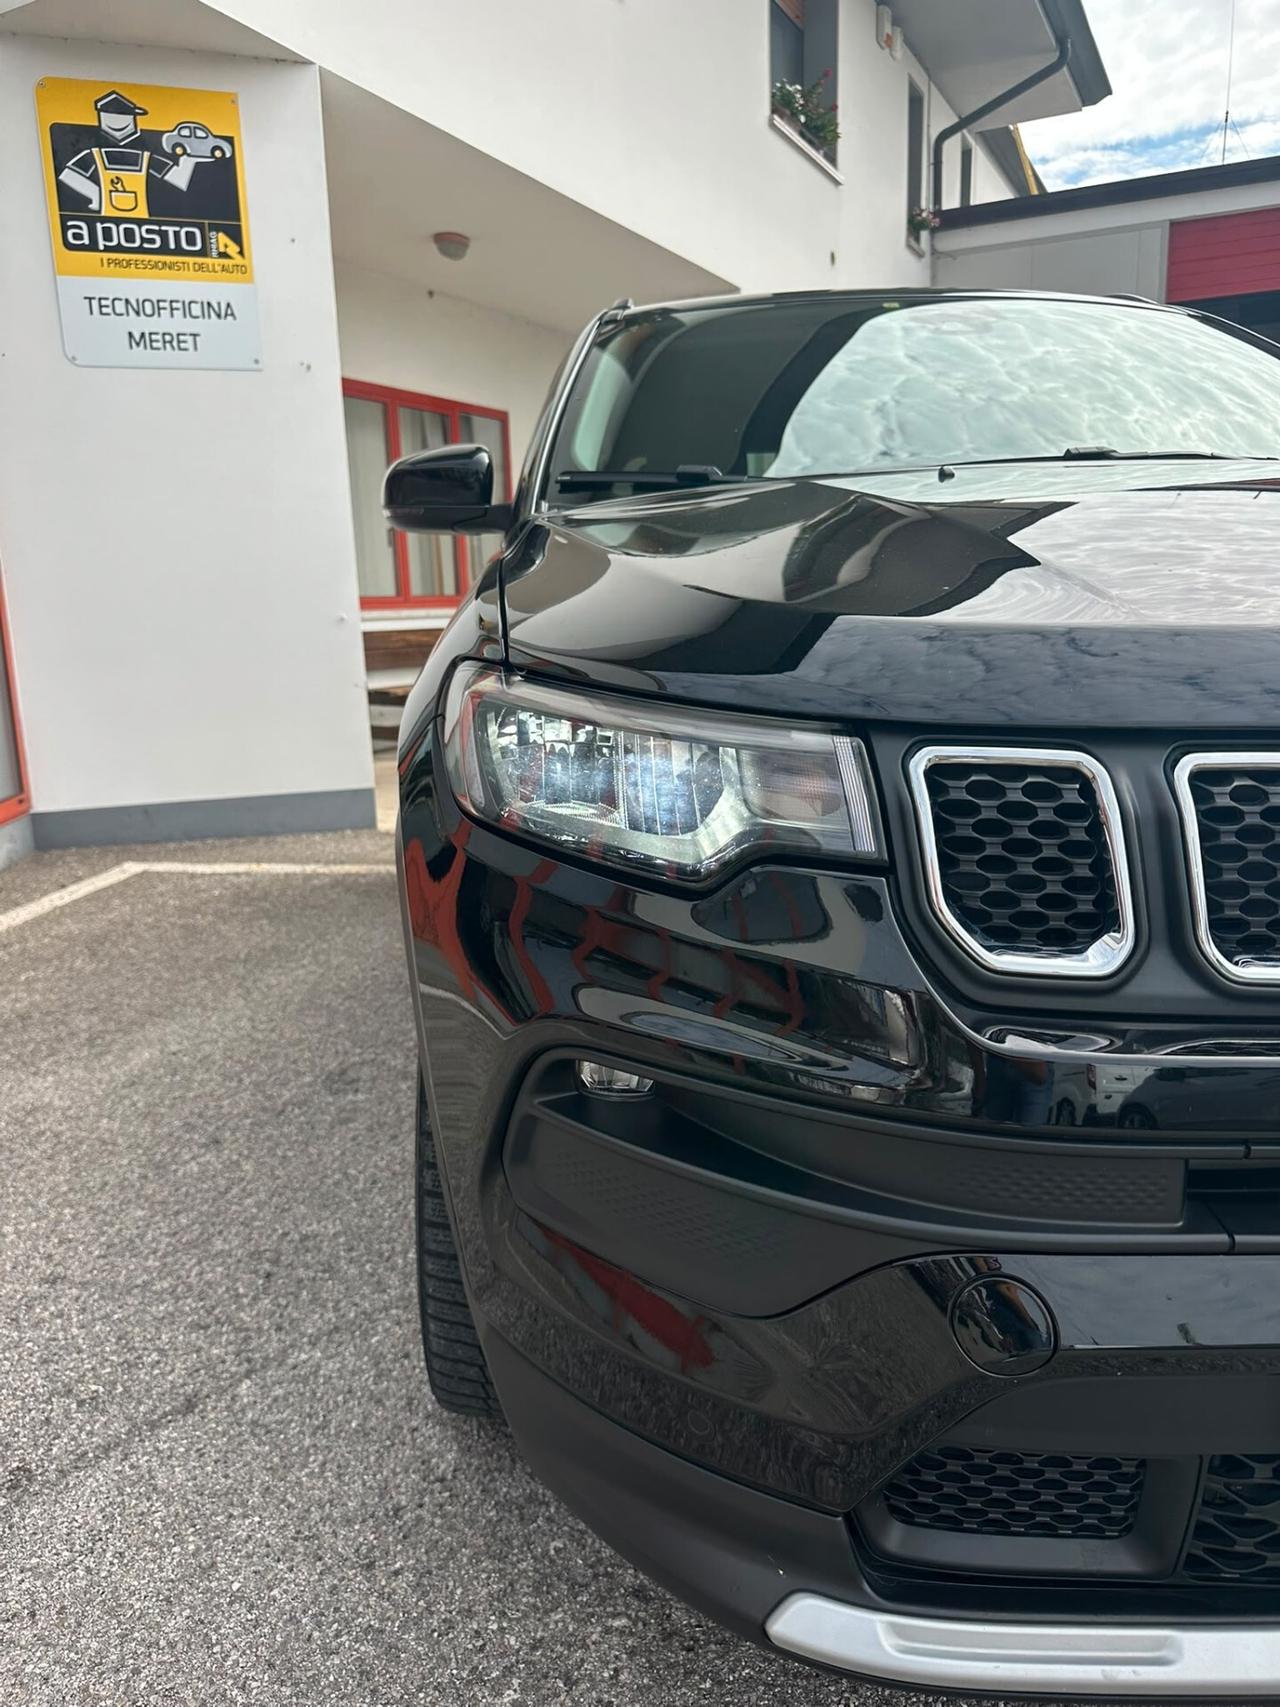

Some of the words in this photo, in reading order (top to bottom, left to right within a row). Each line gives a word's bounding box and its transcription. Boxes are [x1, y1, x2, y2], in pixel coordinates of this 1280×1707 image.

[66, 220, 89, 245] a
[106, 258, 190, 272] PROFESSIONISTI
[192, 262, 248, 275] DELL'AUTO
[83, 296, 237, 321] TECNOFFICINA
[127, 331, 201, 352] MERET
